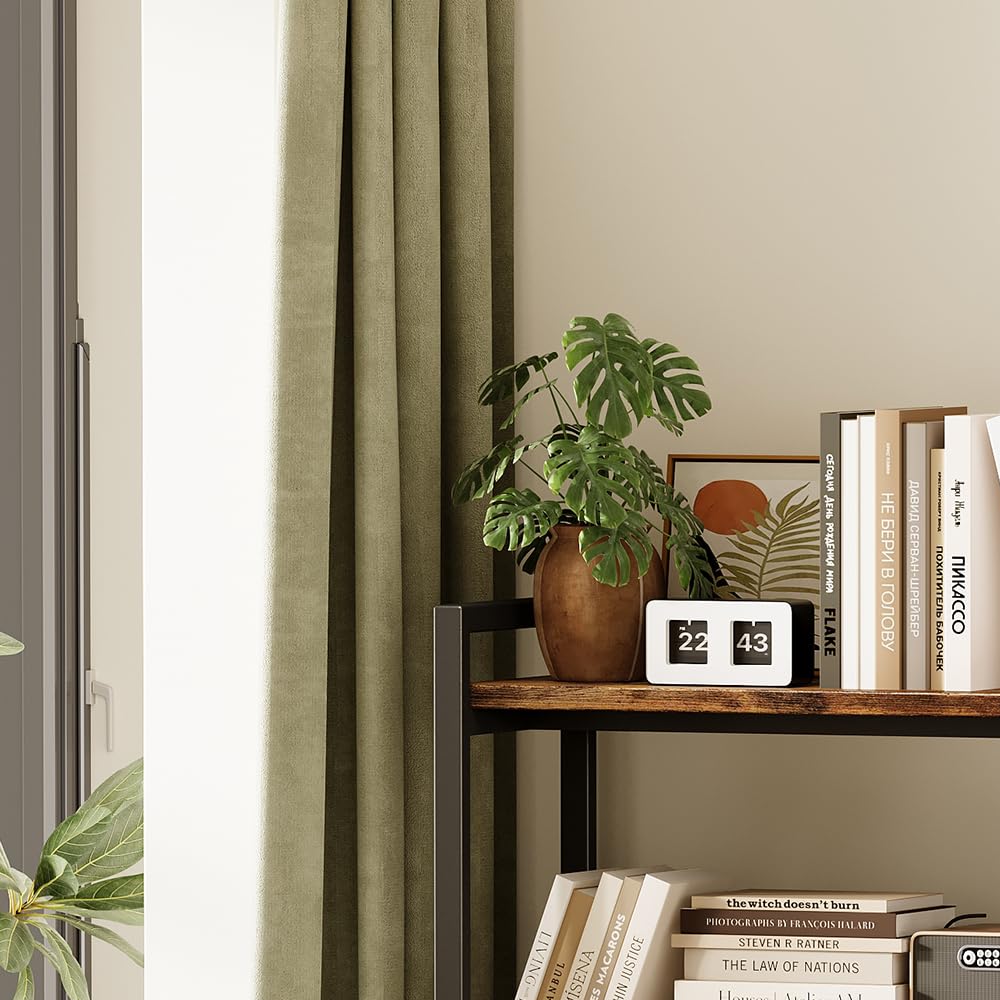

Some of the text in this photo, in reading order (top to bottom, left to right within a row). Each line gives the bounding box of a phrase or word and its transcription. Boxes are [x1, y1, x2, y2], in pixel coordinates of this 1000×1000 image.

[823, 453, 835, 593] СЕГОДНЯ ДЕНЬ РОЖДЕНИЯ МИРА
[881, 492, 895, 514] НЕ
[881, 519, 895, 562] БЕРИ
[908, 480, 921, 638] ДАВИД СЕРВАН-ШРЕЙБЕР
[881, 567, 895, 579] В
[936, 546, 944, 672] ПОХИТИТЕЛЬ БАБОЧЕК
[951, 555, 966, 635] ПИКАССО
[824, 608, 836, 657] FLAKE
[881, 584, 895, 653] ГОЛОВУ
[678, 632, 709, 651] 22
[736, 633, 768, 653] 43
[705, 917, 875, 930] PHOTOGRAPHS BY FRANÇOIS HALARD
[727, 898, 748, 908] the
[748, 899, 782, 909] witch
[831, 900, 860, 910] burn
[596, 913, 626, 985] MACARONS
[621, 936, 645, 982] JUSTICE
[738, 938, 840, 949] STEVEN R RATNER
[722, 959, 860, 974] THE LAW OF NATIONS
